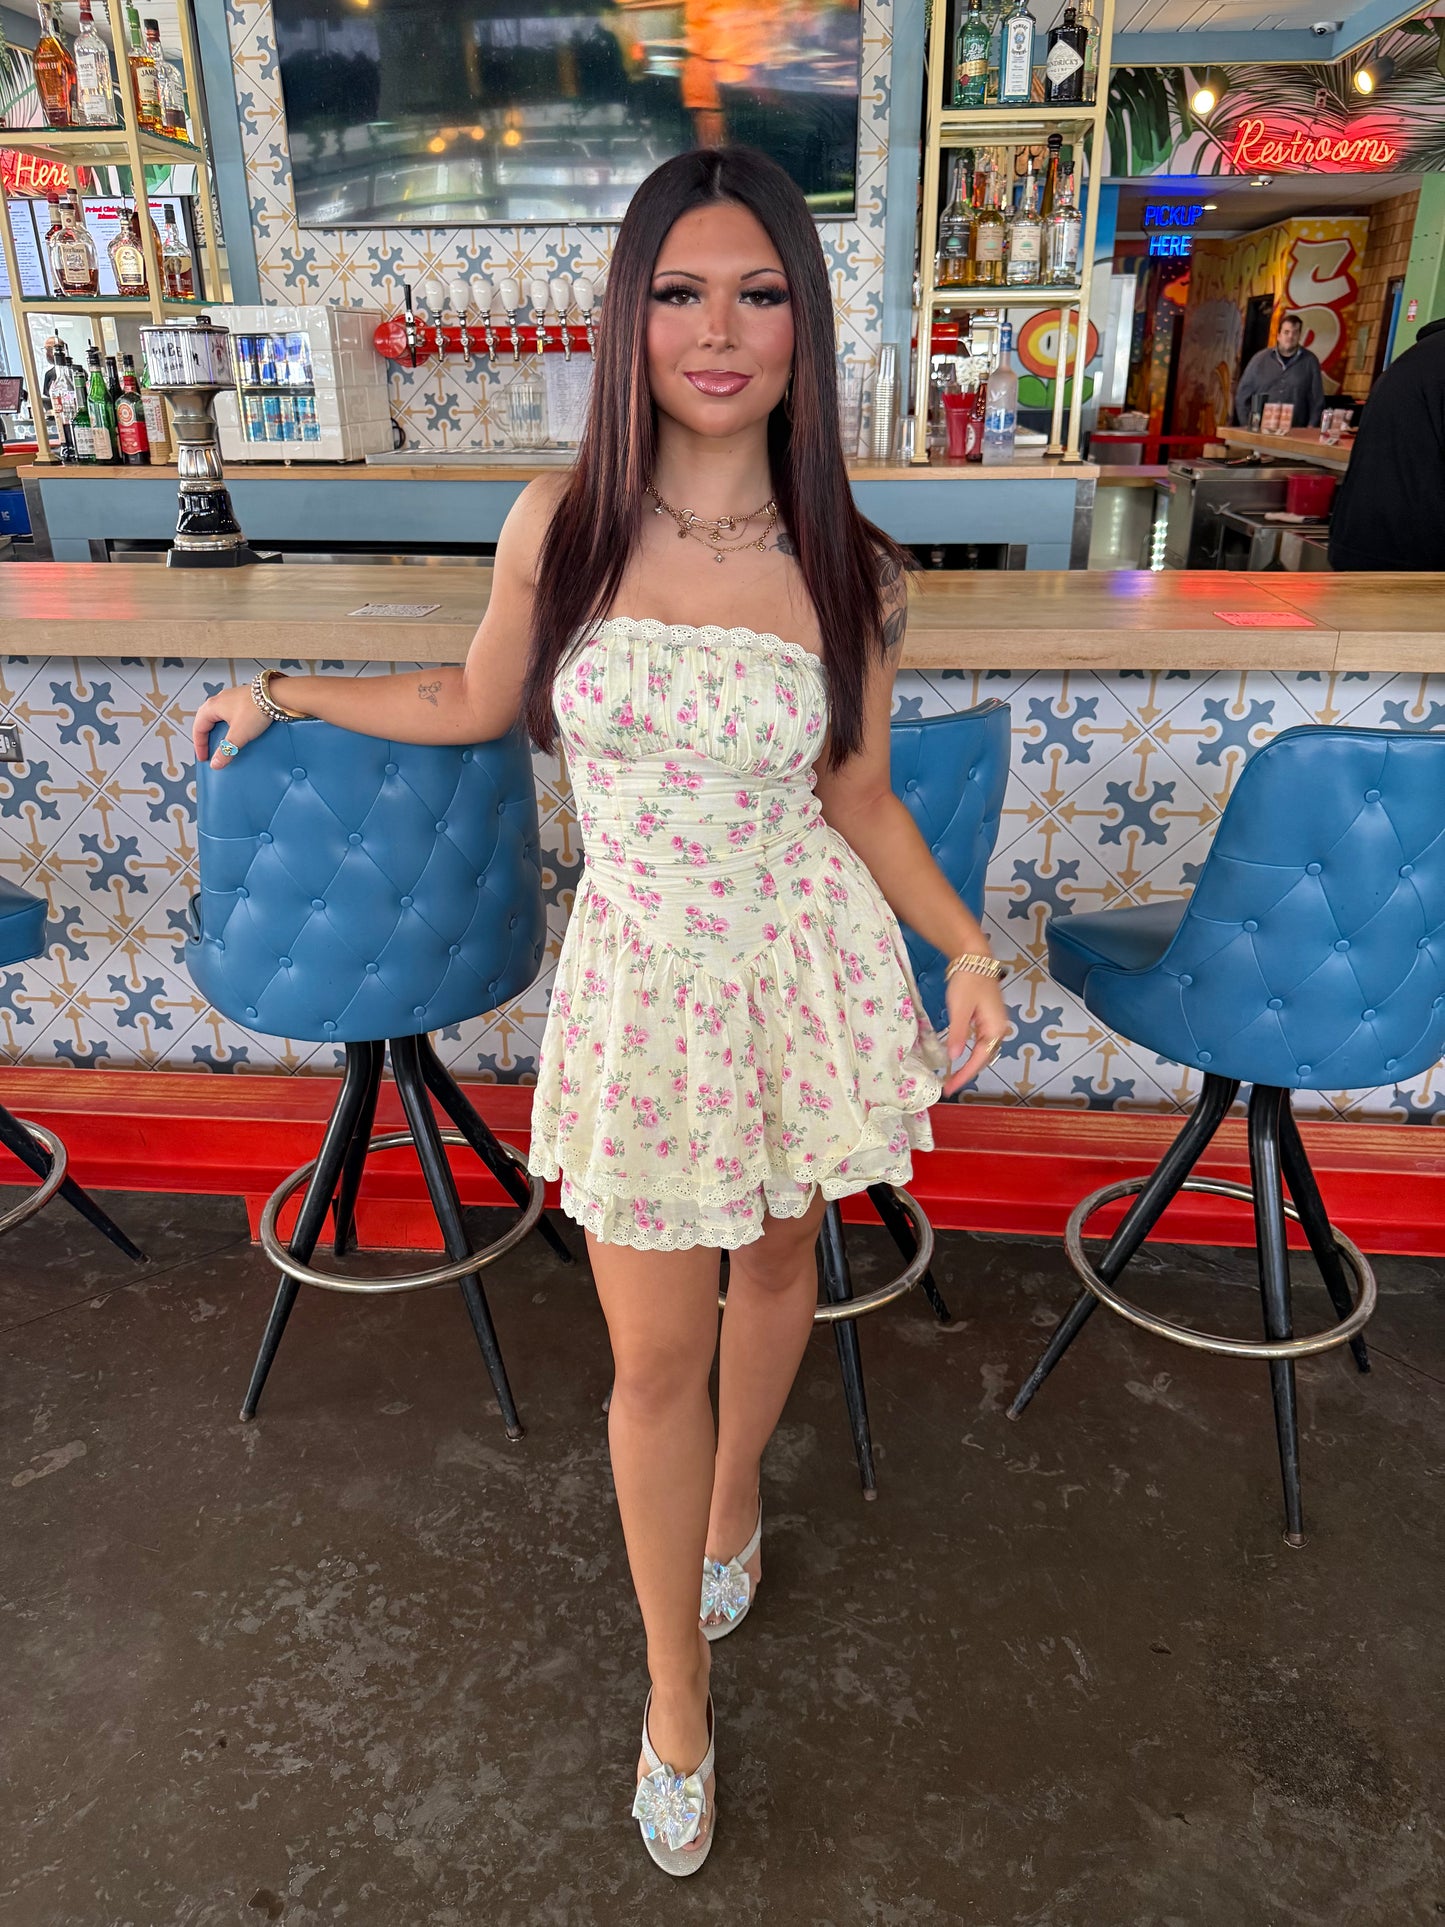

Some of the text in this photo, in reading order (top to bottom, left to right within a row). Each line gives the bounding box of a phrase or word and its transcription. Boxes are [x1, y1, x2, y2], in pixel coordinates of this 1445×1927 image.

[1232, 118, 1396, 165] Restrooms
[15, 151, 70, 188] Here
[1144, 204, 1203, 227] PICKUP
[1148, 234, 1193, 257] HERE
